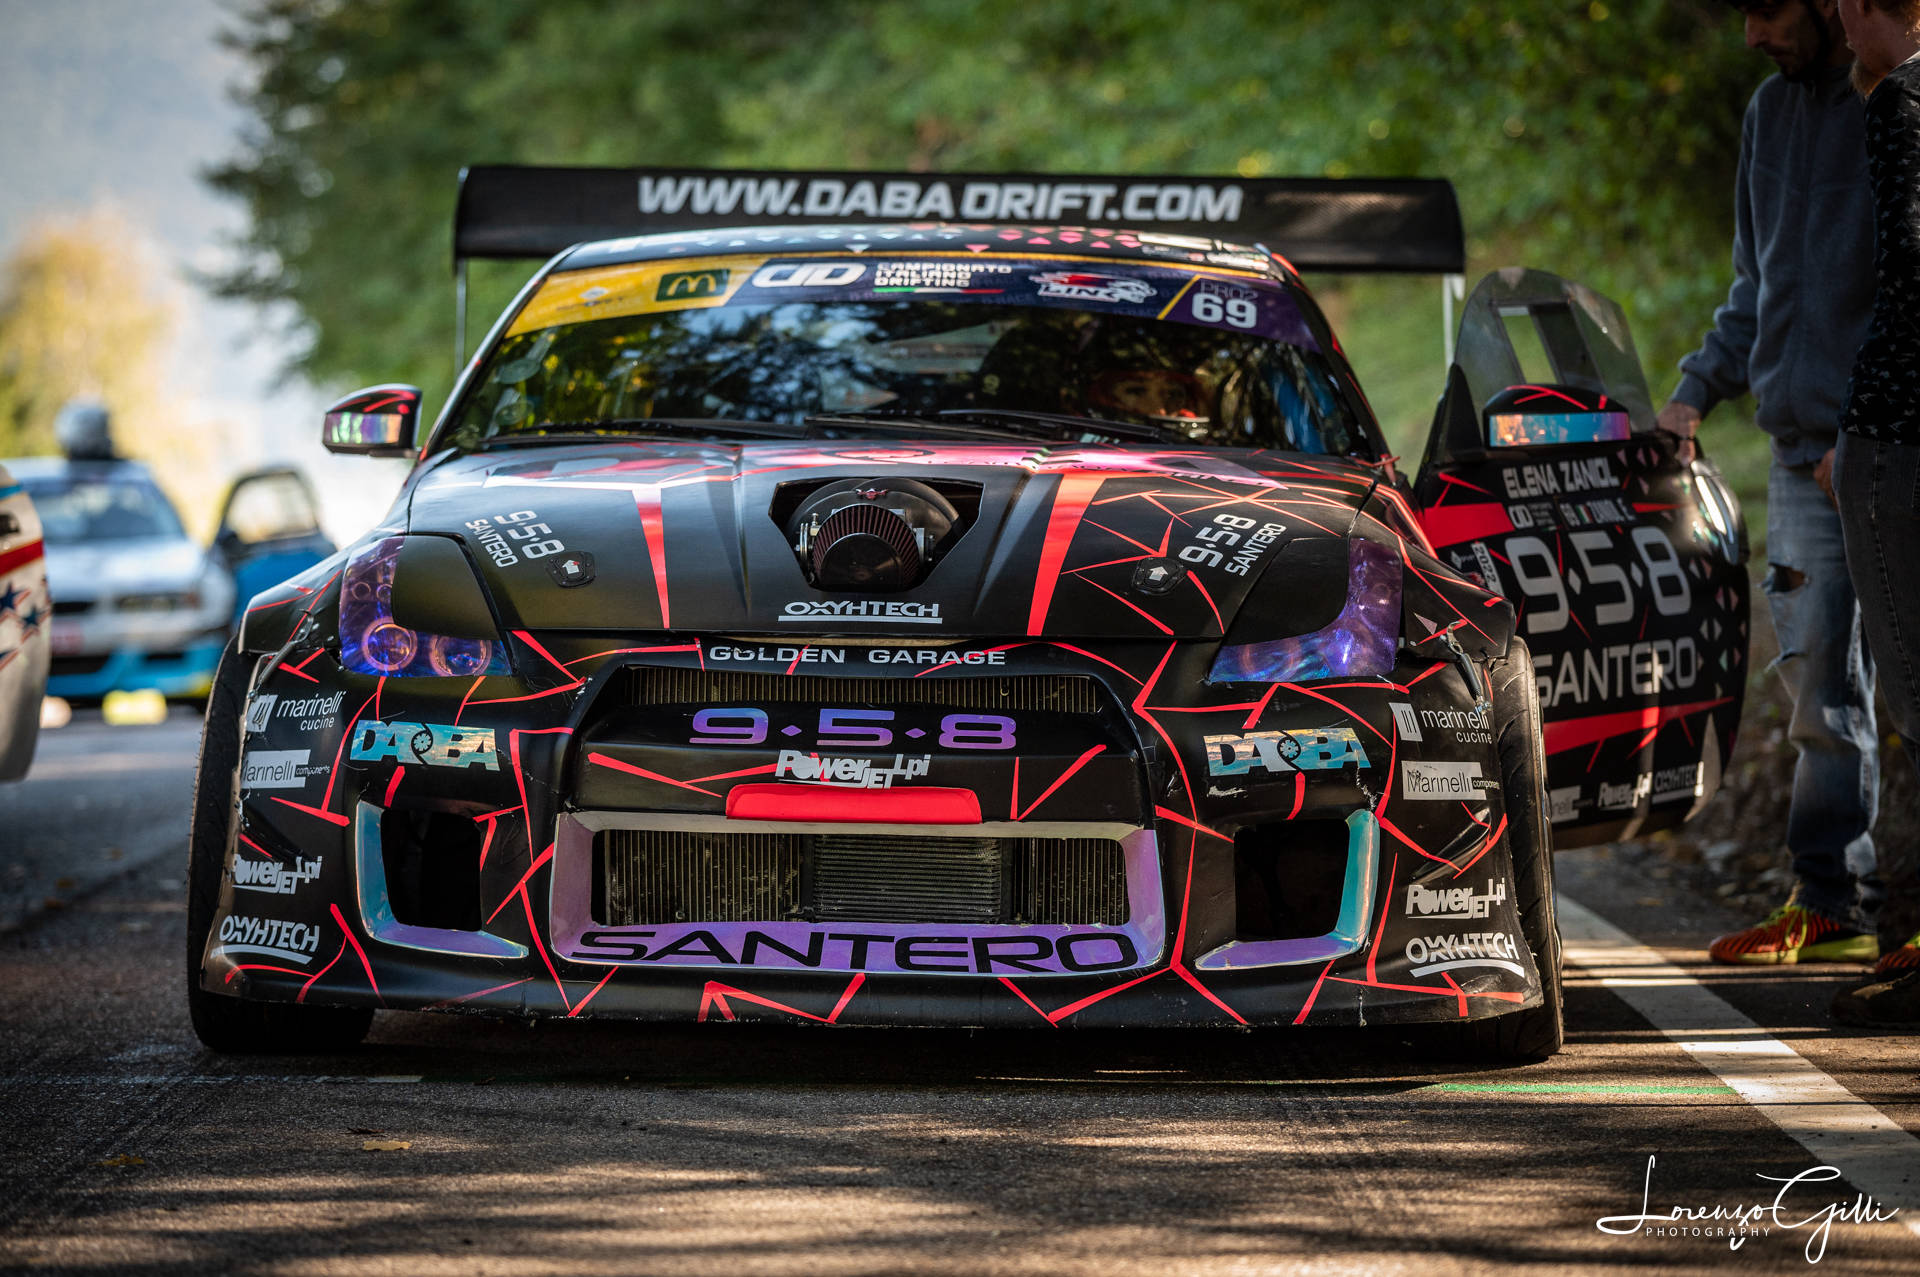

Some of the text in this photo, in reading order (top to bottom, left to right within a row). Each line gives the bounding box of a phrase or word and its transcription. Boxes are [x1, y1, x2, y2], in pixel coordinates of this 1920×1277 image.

[1191, 292, 1258, 328] 69
[1502, 464, 1561, 499] ELENA
[465, 518, 519, 568] SANTERO
[1224, 522, 1287, 576] SANTERO
[1474, 546, 1497, 583] 2022
[784, 600, 939, 618] OXYHTECH
[708, 645, 1006, 665] GOLDEN GARAGE
[1532, 636, 1697, 708] SANTERO
[276, 690, 347, 718] marinelli
[1420, 705, 1490, 730] marinelli
[300, 715, 335, 731] cucine
[1456, 730, 1493, 744] cucine
[1406, 769, 1471, 793] Marinelli
[219, 915, 320, 953] OXYHTECH
[1405, 932, 1520, 964] OXYHTECH
[571, 929, 1139, 975] SANTERO
